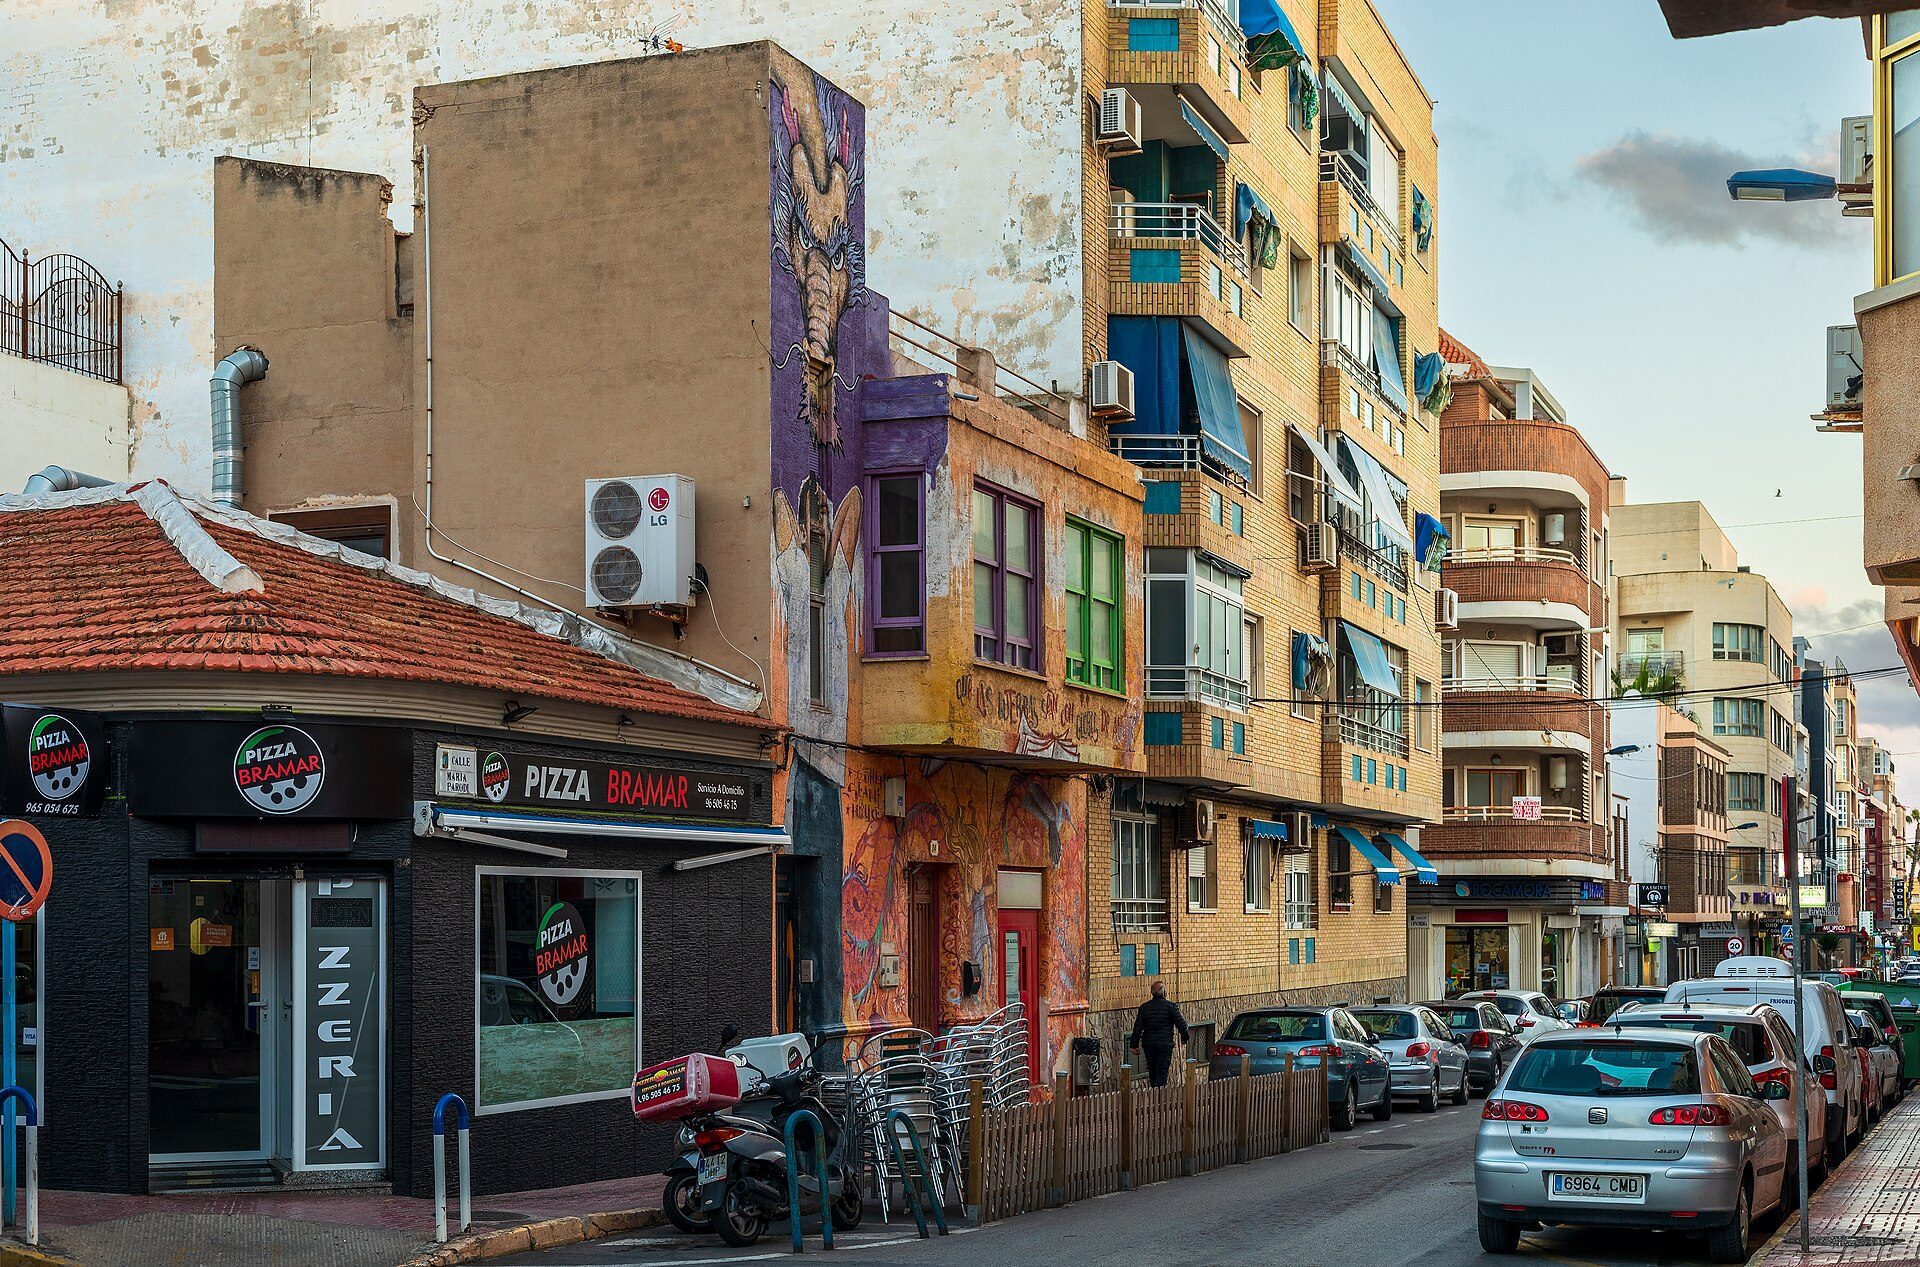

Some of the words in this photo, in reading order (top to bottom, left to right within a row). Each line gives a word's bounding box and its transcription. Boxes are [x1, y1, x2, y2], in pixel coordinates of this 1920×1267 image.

[651, 515, 668, 527] LG
[36, 730, 71, 751] PIZZA
[31, 742, 88, 772] BRAMAR
[245, 741, 298, 764] PIZZA
[451, 756, 471, 767] CALLE
[238, 755, 322, 786] BRAMAR
[485, 761, 502, 774] PIZZA
[447, 772, 467, 783] MARIA
[525, 764, 591, 802] PIZZA
[607, 769, 689, 809] BRAMAR
[25, 802, 43, 814] 965
[44, 803, 61, 814] 054
[62, 804, 80, 815] 675
[1473, 883, 1551, 897] ROCAMORA
[1896, 880, 1904, 919] BODEGA
[540, 918, 573, 948] PIZZA
[536, 933, 588, 975] BRAMAR
[318, 879, 363, 1151] PZZERIA
[25, 1032, 36, 1040] VISA
[641, 1093, 650, 1102] 96
[650, 1089, 662, 1100] 505
[662, 1086, 671, 1095] 46
[671, 1083, 681, 1092] 75
[705, 1154, 727, 1169] 4412
[1564, 1176, 1601, 1191] 6964
[1609, 1178, 1638, 1193] CMD
